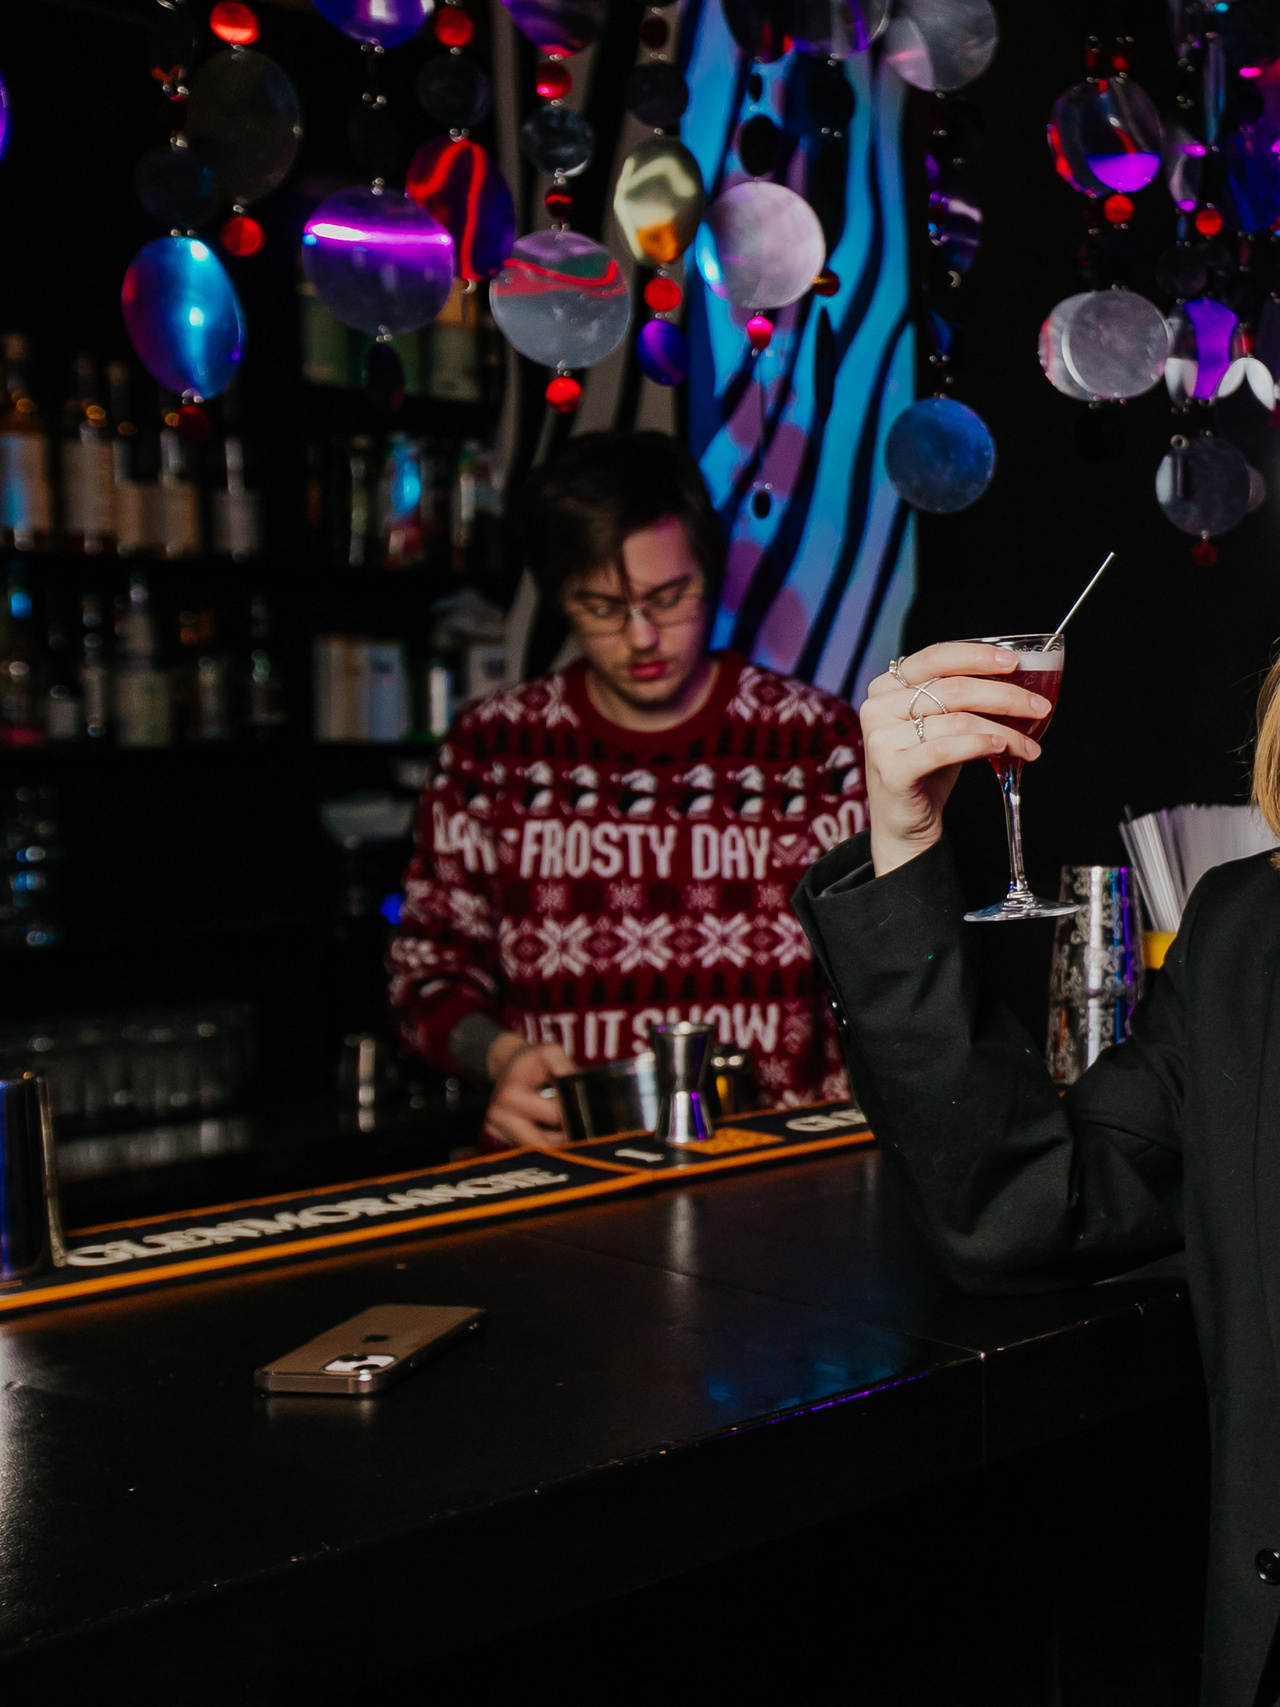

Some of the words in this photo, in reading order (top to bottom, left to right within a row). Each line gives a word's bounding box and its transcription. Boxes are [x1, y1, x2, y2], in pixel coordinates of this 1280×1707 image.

[519, 818, 678, 880] FROSTY
[691, 822, 773, 881] DAY
[583, 1008, 628, 1061] IT
[631, 1001, 781, 1056] SOW
[64, 1167, 569, 1267] GLENMORANGIE
